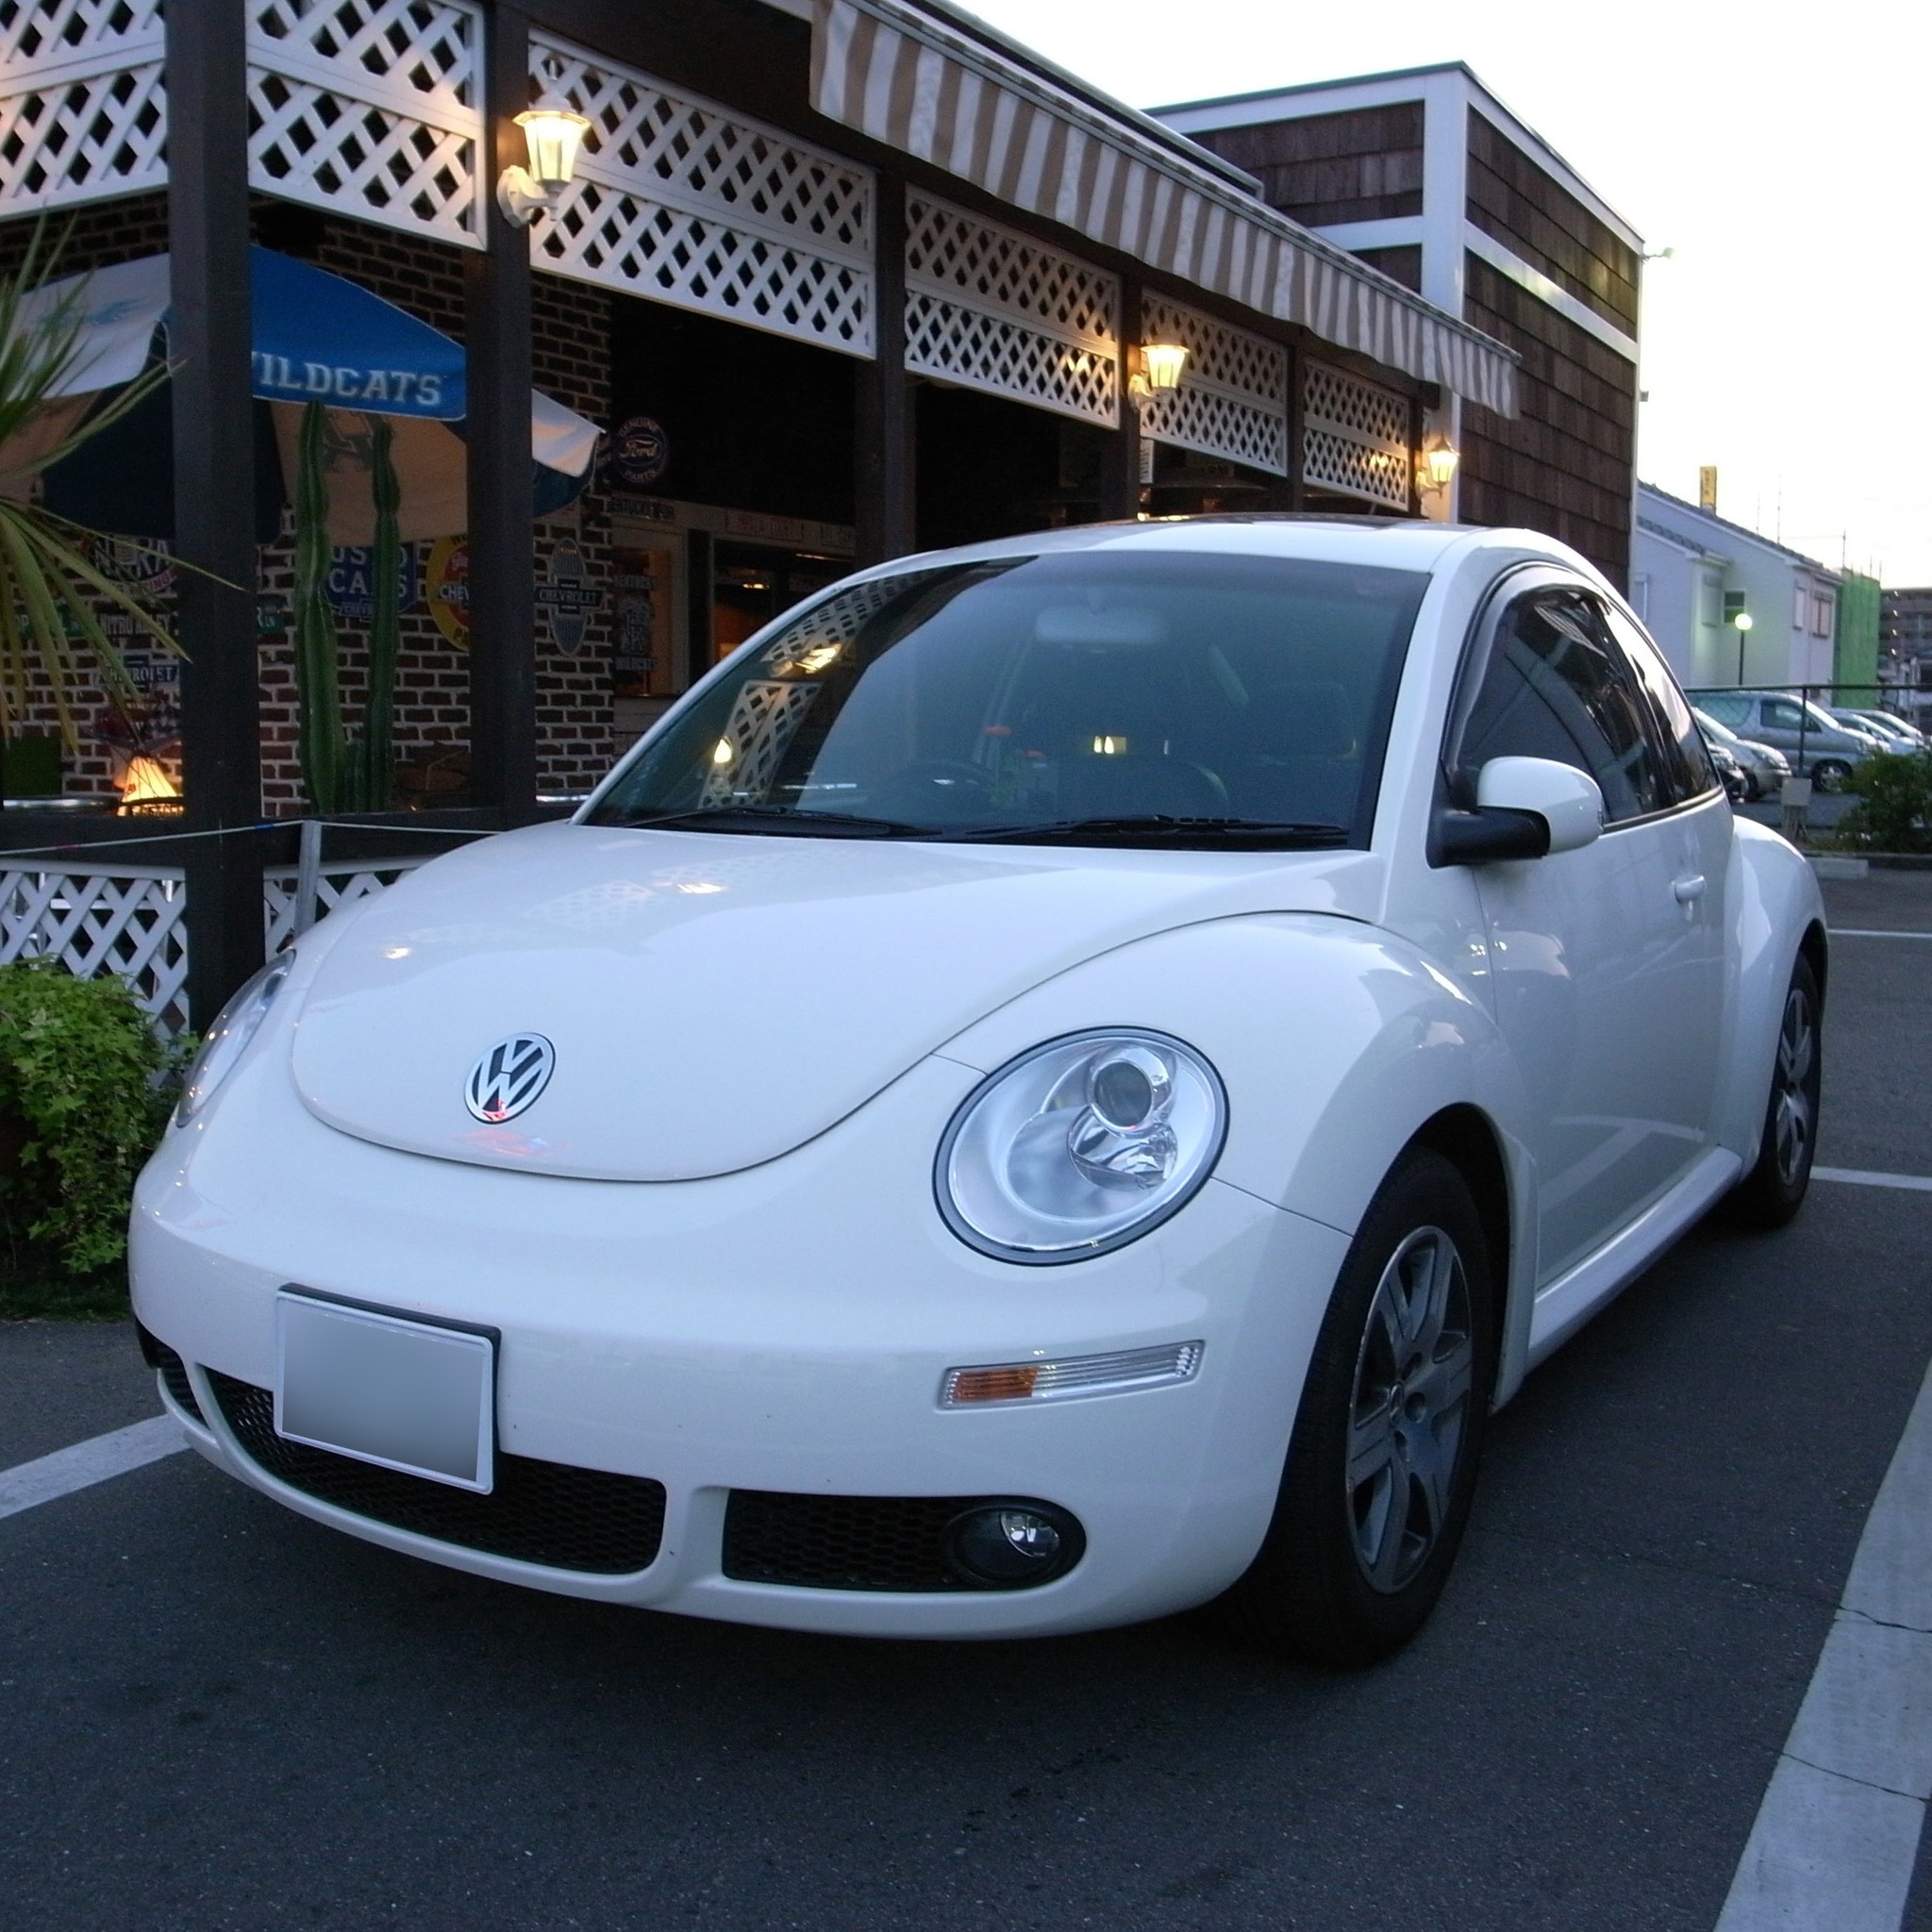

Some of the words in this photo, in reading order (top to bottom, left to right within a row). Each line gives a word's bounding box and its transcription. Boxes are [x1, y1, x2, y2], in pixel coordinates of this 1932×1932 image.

[252, 351, 442, 406] ILDCATS
[619, 438, 659, 458] Ford
[328, 568, 408, 598] CAS
[539, 590, 598, 606] CHEVROLET
[471, 1036, 549, 1117] VW
